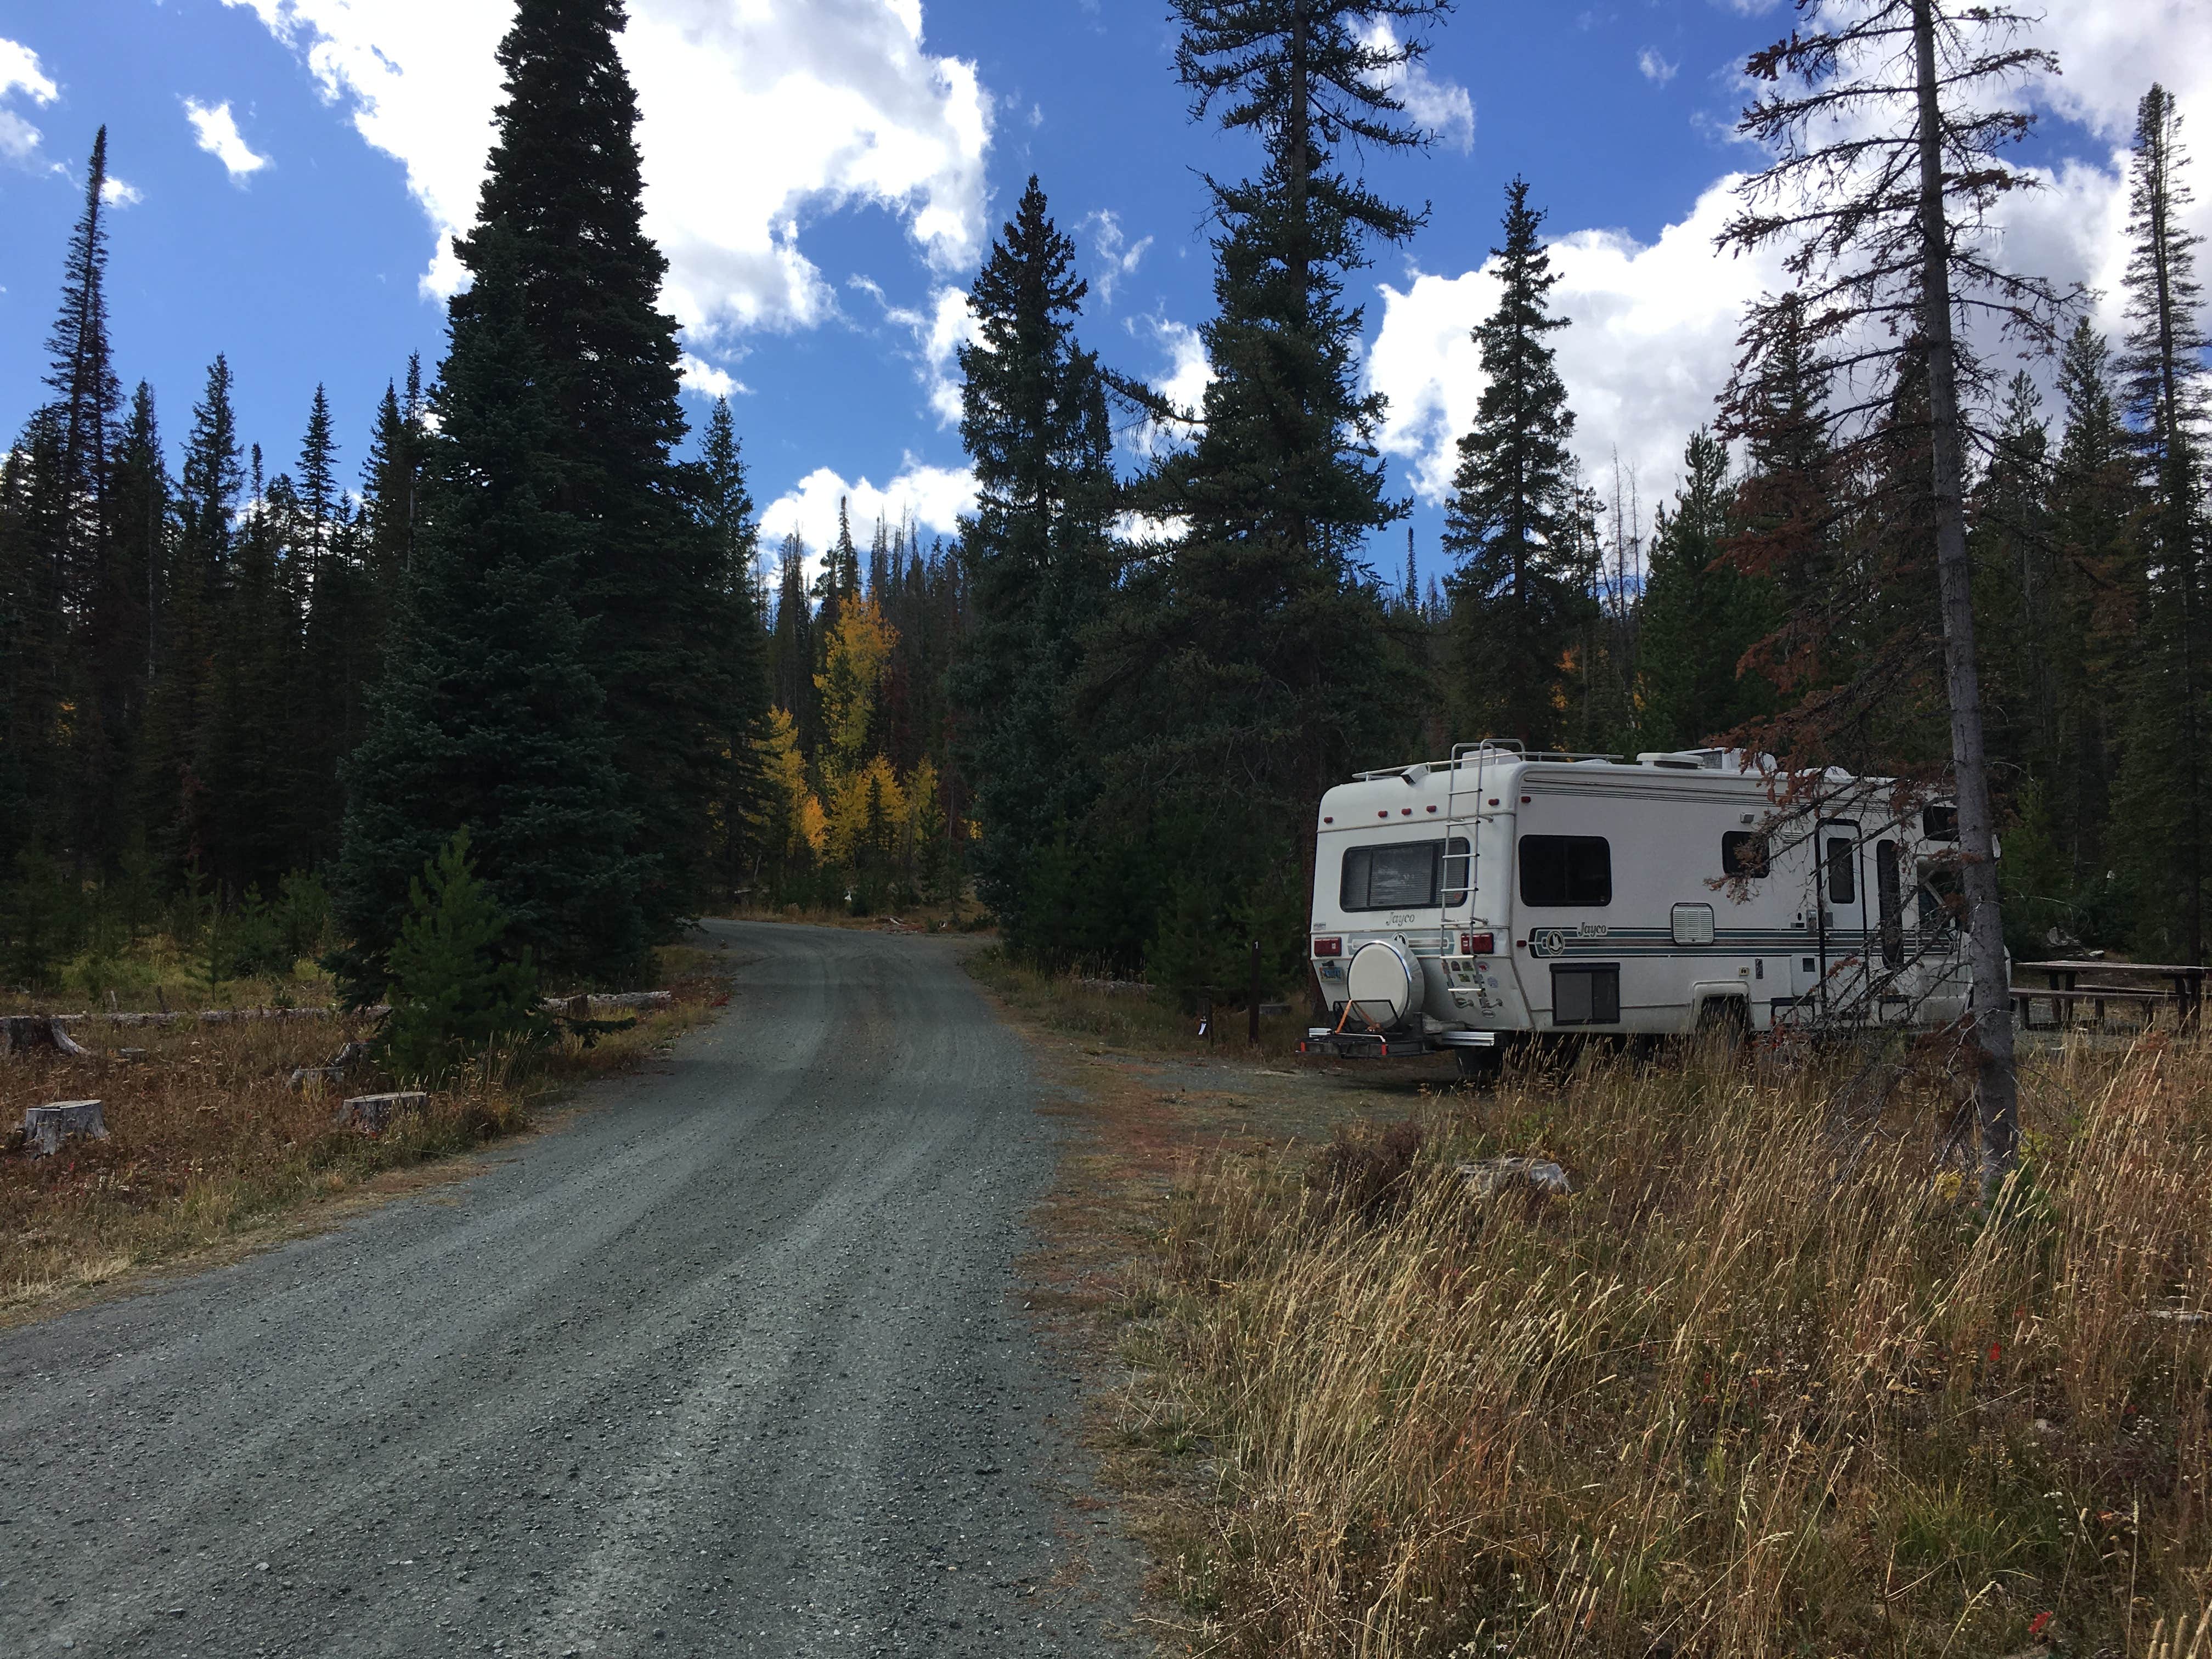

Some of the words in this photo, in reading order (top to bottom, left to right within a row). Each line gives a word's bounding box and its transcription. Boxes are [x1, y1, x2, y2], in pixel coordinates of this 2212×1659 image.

[1386, 912, 1415, 927] Jayco
[1578, 922, 1607, 937] Jayco
[1254, 940, 1259, 949] 1
